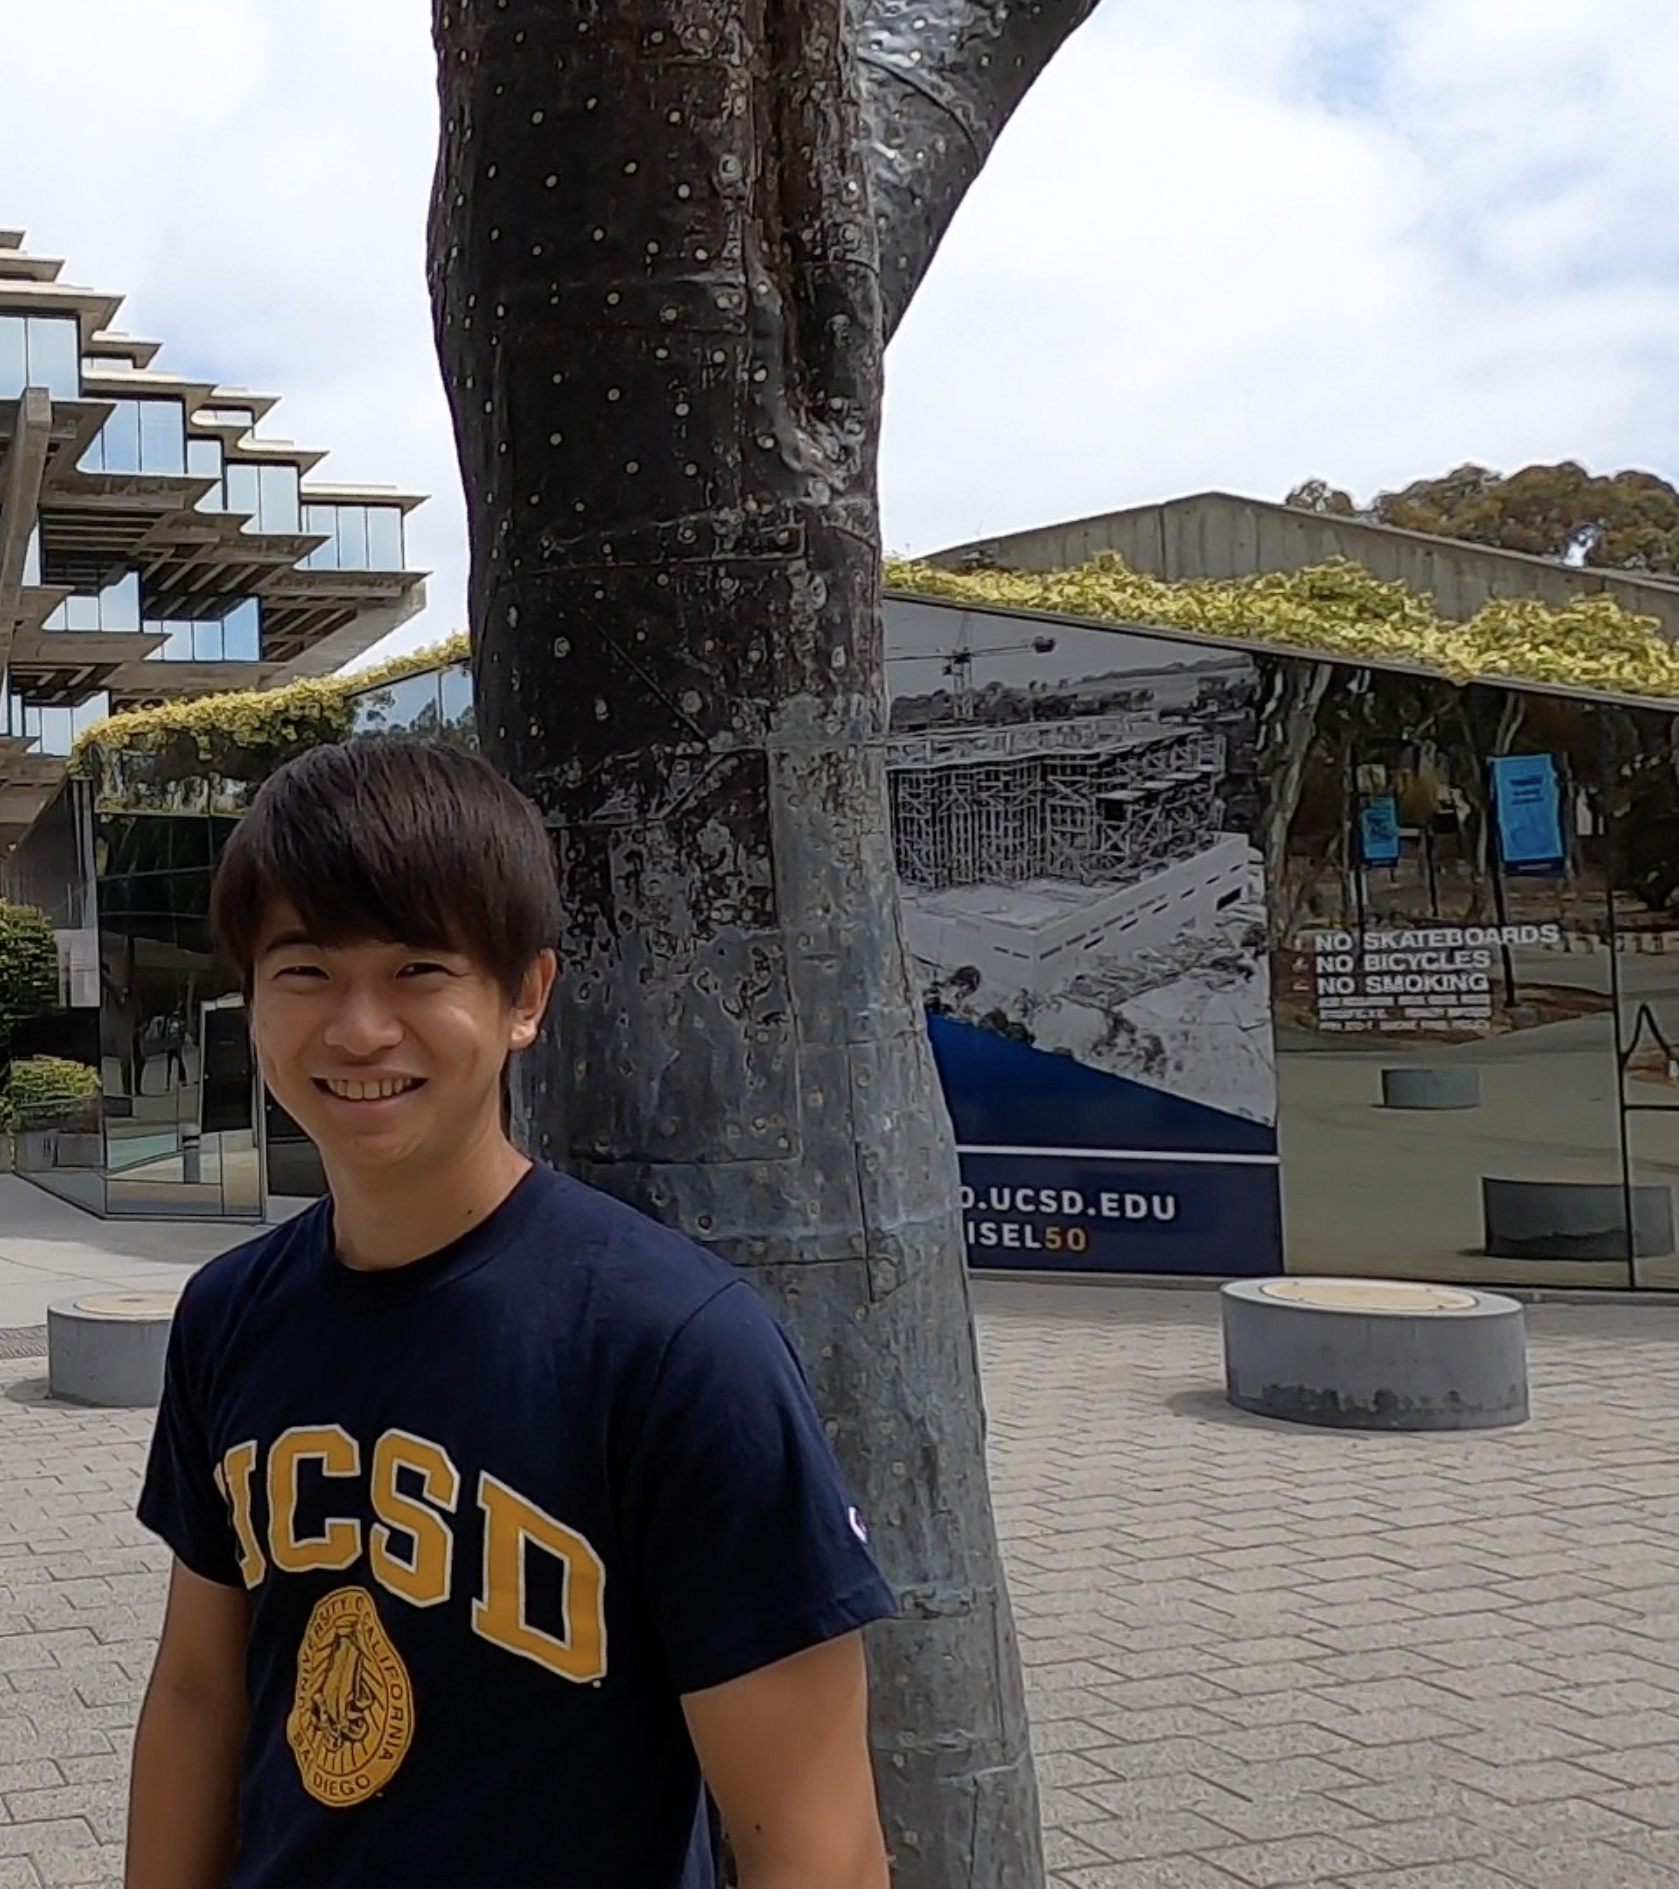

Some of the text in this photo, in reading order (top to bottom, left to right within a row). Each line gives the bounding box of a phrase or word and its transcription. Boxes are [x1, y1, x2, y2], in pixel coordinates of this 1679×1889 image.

[1315, 925, 1560, 951] NO SKATEBOARDS
[1316, 950, 1491, 973] NO BICYCLES
[1317, 974, 1489, 995] NO SMOKING
[967, 1221, 1088, 1251] ISEL50
[312, 1773, 371, 1797] DIEGO
